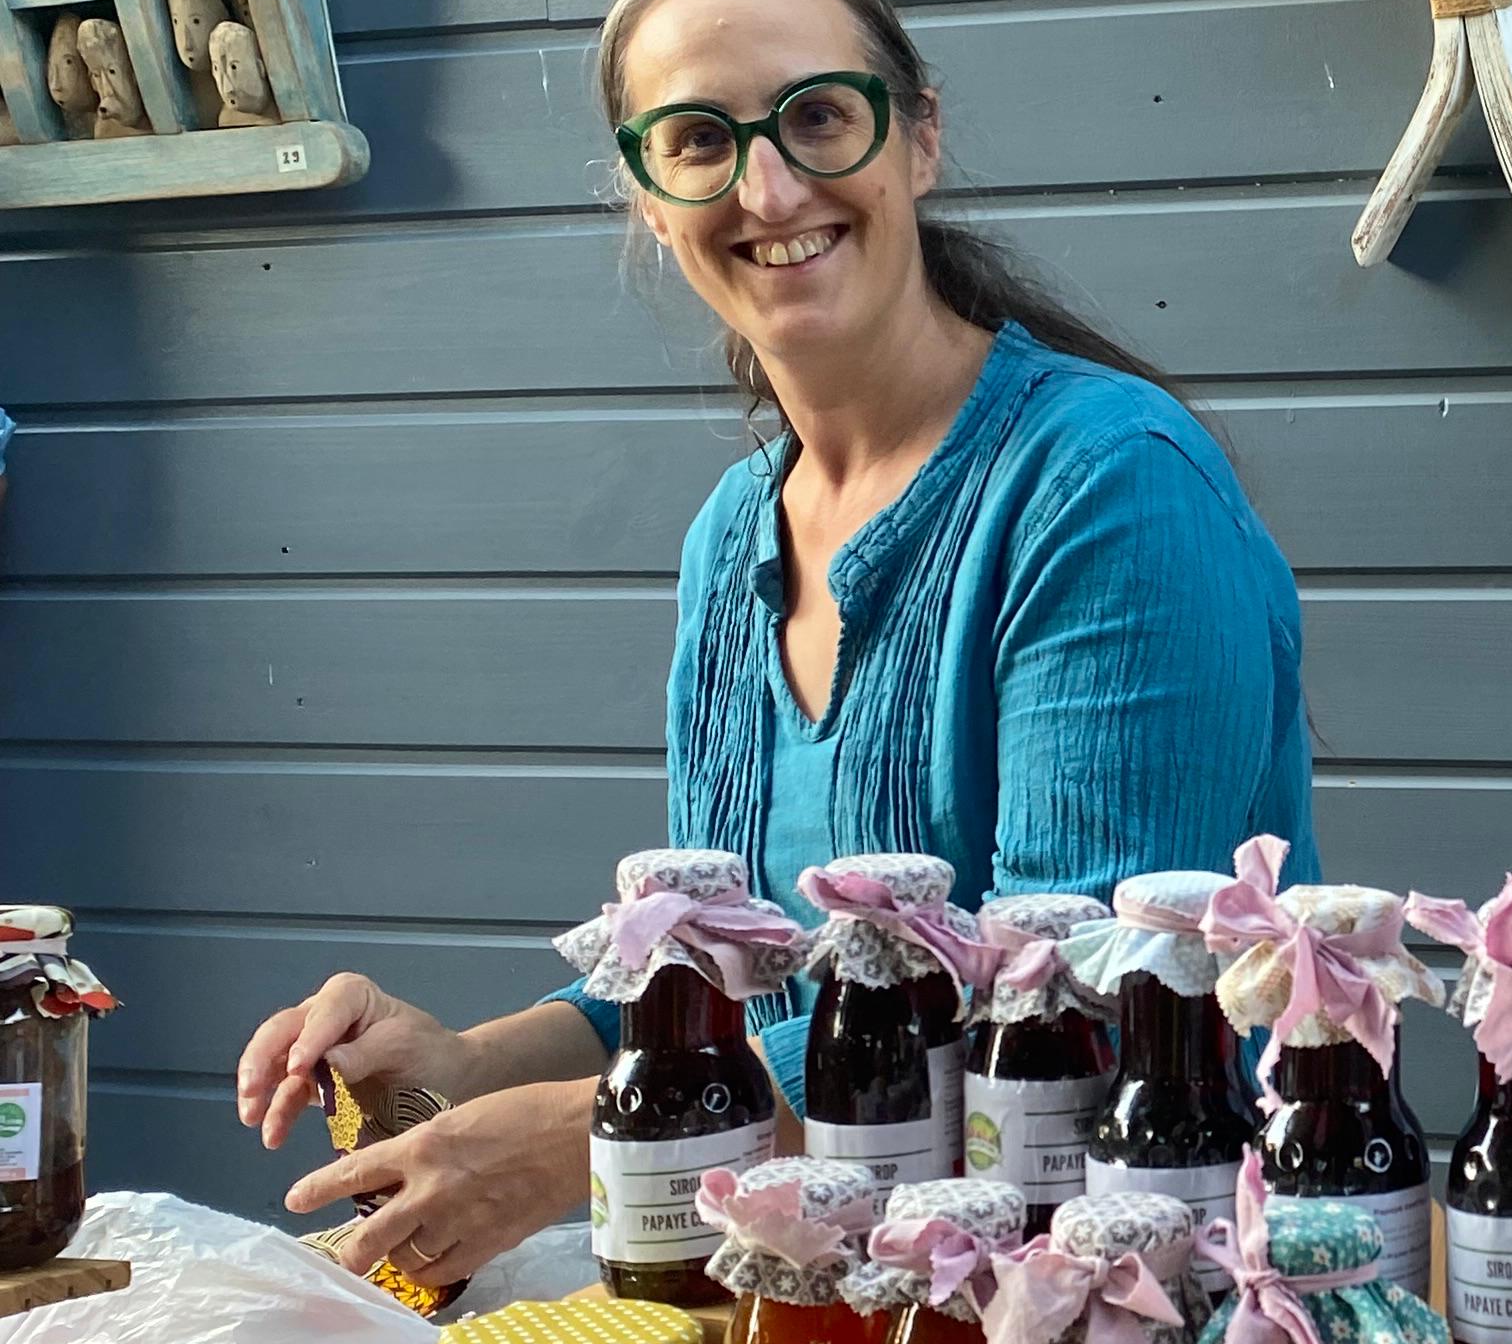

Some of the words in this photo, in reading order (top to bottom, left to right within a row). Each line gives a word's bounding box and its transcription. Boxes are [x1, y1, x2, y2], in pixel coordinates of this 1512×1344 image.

[282, 150, 300, 165] 29
[872, 1163, 898, 1181] ROP
[669, 1174, 701, 1197] SIRO
[641, 1211, 687, 1232] PAPAYE
[1464, 1292, 1502, 1316] PAPAYE
